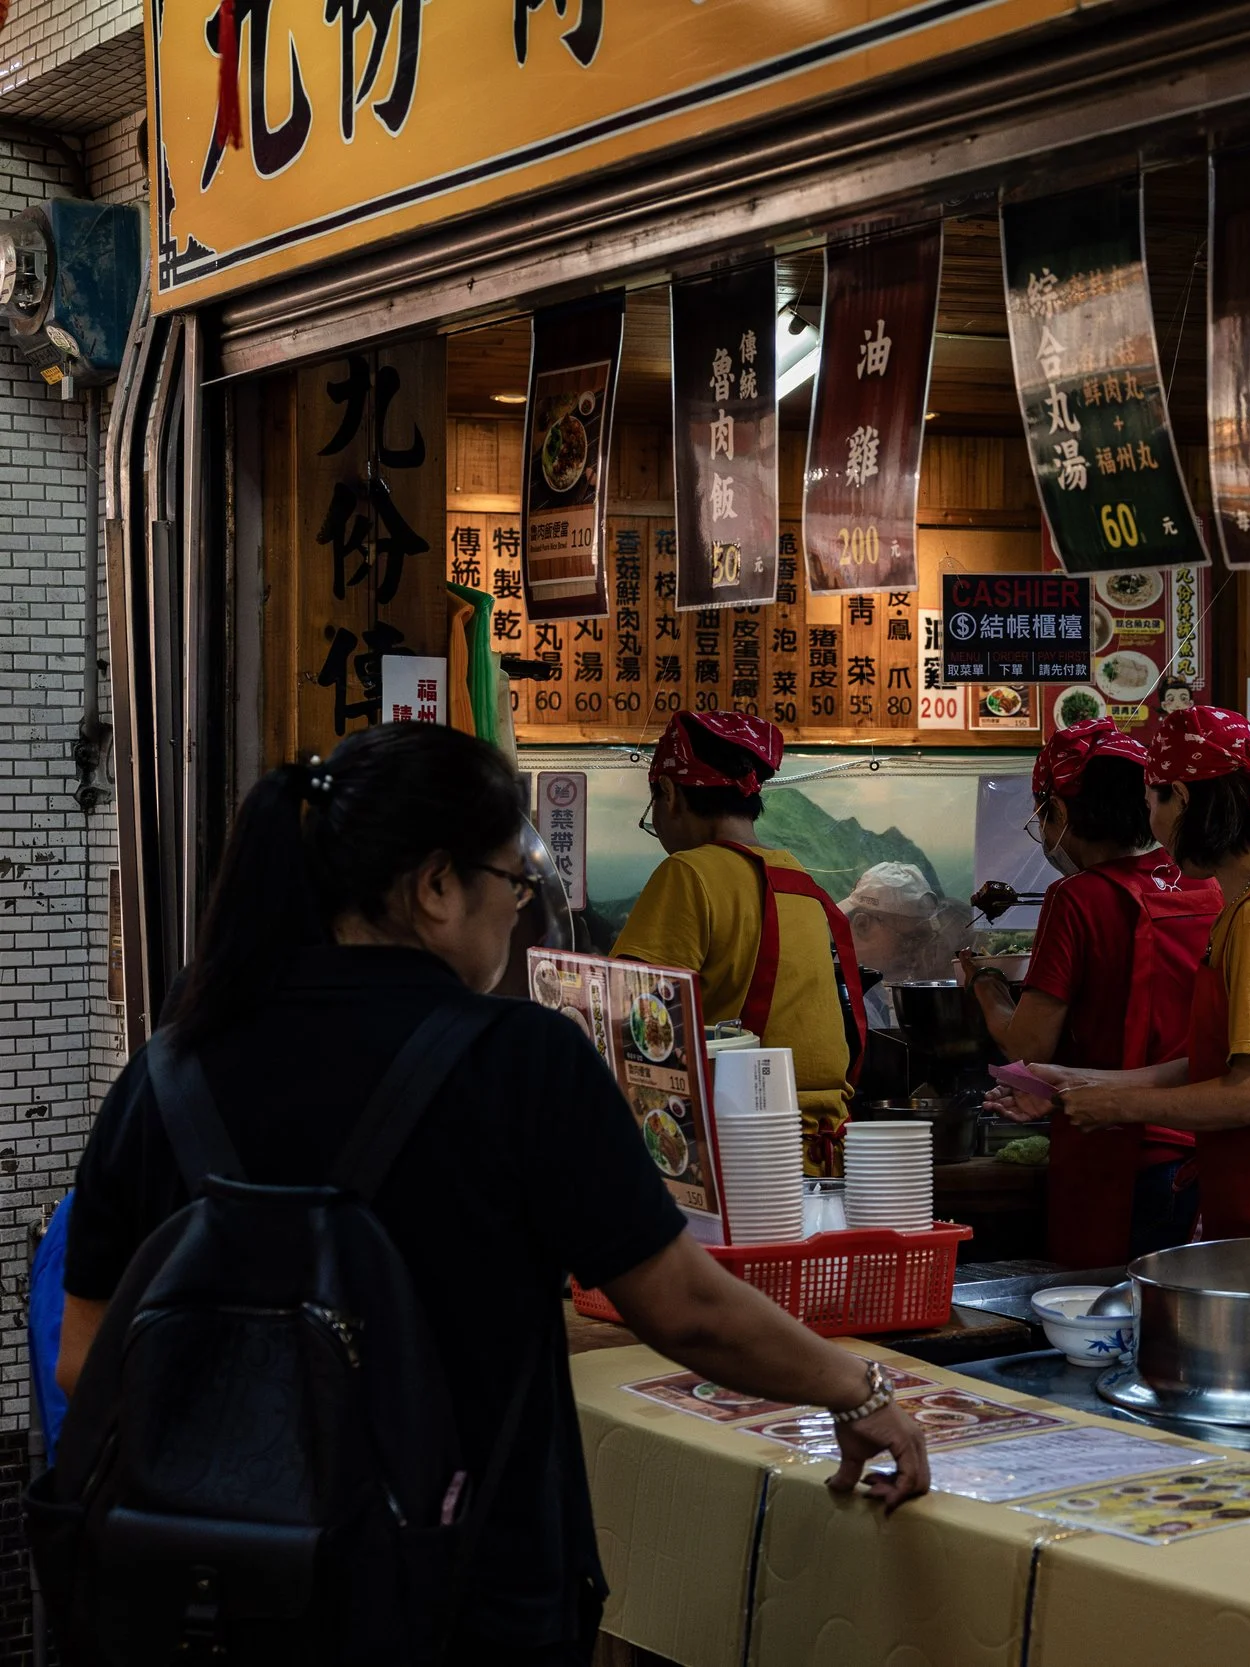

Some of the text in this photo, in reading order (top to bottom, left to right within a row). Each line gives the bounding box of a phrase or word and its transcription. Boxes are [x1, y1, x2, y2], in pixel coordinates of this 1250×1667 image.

[739, 329, 758, 400] 傳統
[1026, 267, 1089, 492] 綜合丸湯
[1082, 371, 1144, 407] 鮮肉丸
[844, 319, 893, 488] 油雞
[709, 347, 738, 523] 魯肉飯
[1096, 440, 1159, 475] 福州丸
[1101, 502, 1138, 549] 60
[571, 528, 592, 548] 110
[839, 524, 902, 567] 200 元
[451, 526, 481, 588] 傳統
[753, 556, 764, 573] 元
[493, 527, 522, 680] 特製乾
[952, 579, 1081, 608] CASHIER
[615, 530, 642, 683] 香菇鮮肉丸湯
[654, 528, 682, 683] 花枝丸湯
[980, 613, 1083, 640] 結帳櫃檯
[950, 651, 981, 663] MENU
[992, 651, 1029, 663] ORDER
[1037, 651, 1089, 663] PAY FIRST
[947, 664, 985, 677] 取菜單
[999, 664, 1024, 677] 下單
[1038, 664, 1087, 677] 請先付款
[535, 690, 561, 711] 60
[575, 692, 602, 712] 60
[614, 691, 641, 712] 60
[654, 691, 682, 712] 60
[695, 691, 718, 712] 30
[811, 695, 835, 716] 50
[850, 695, 873, 715] 55
[887, 696, 912, 716] 80
[921, 697, 957, 719] 200
[774, 702, 797, 723] 50
[670, 1075, 686, 1092] 110
[687, 1190, 704, 1207] 150
